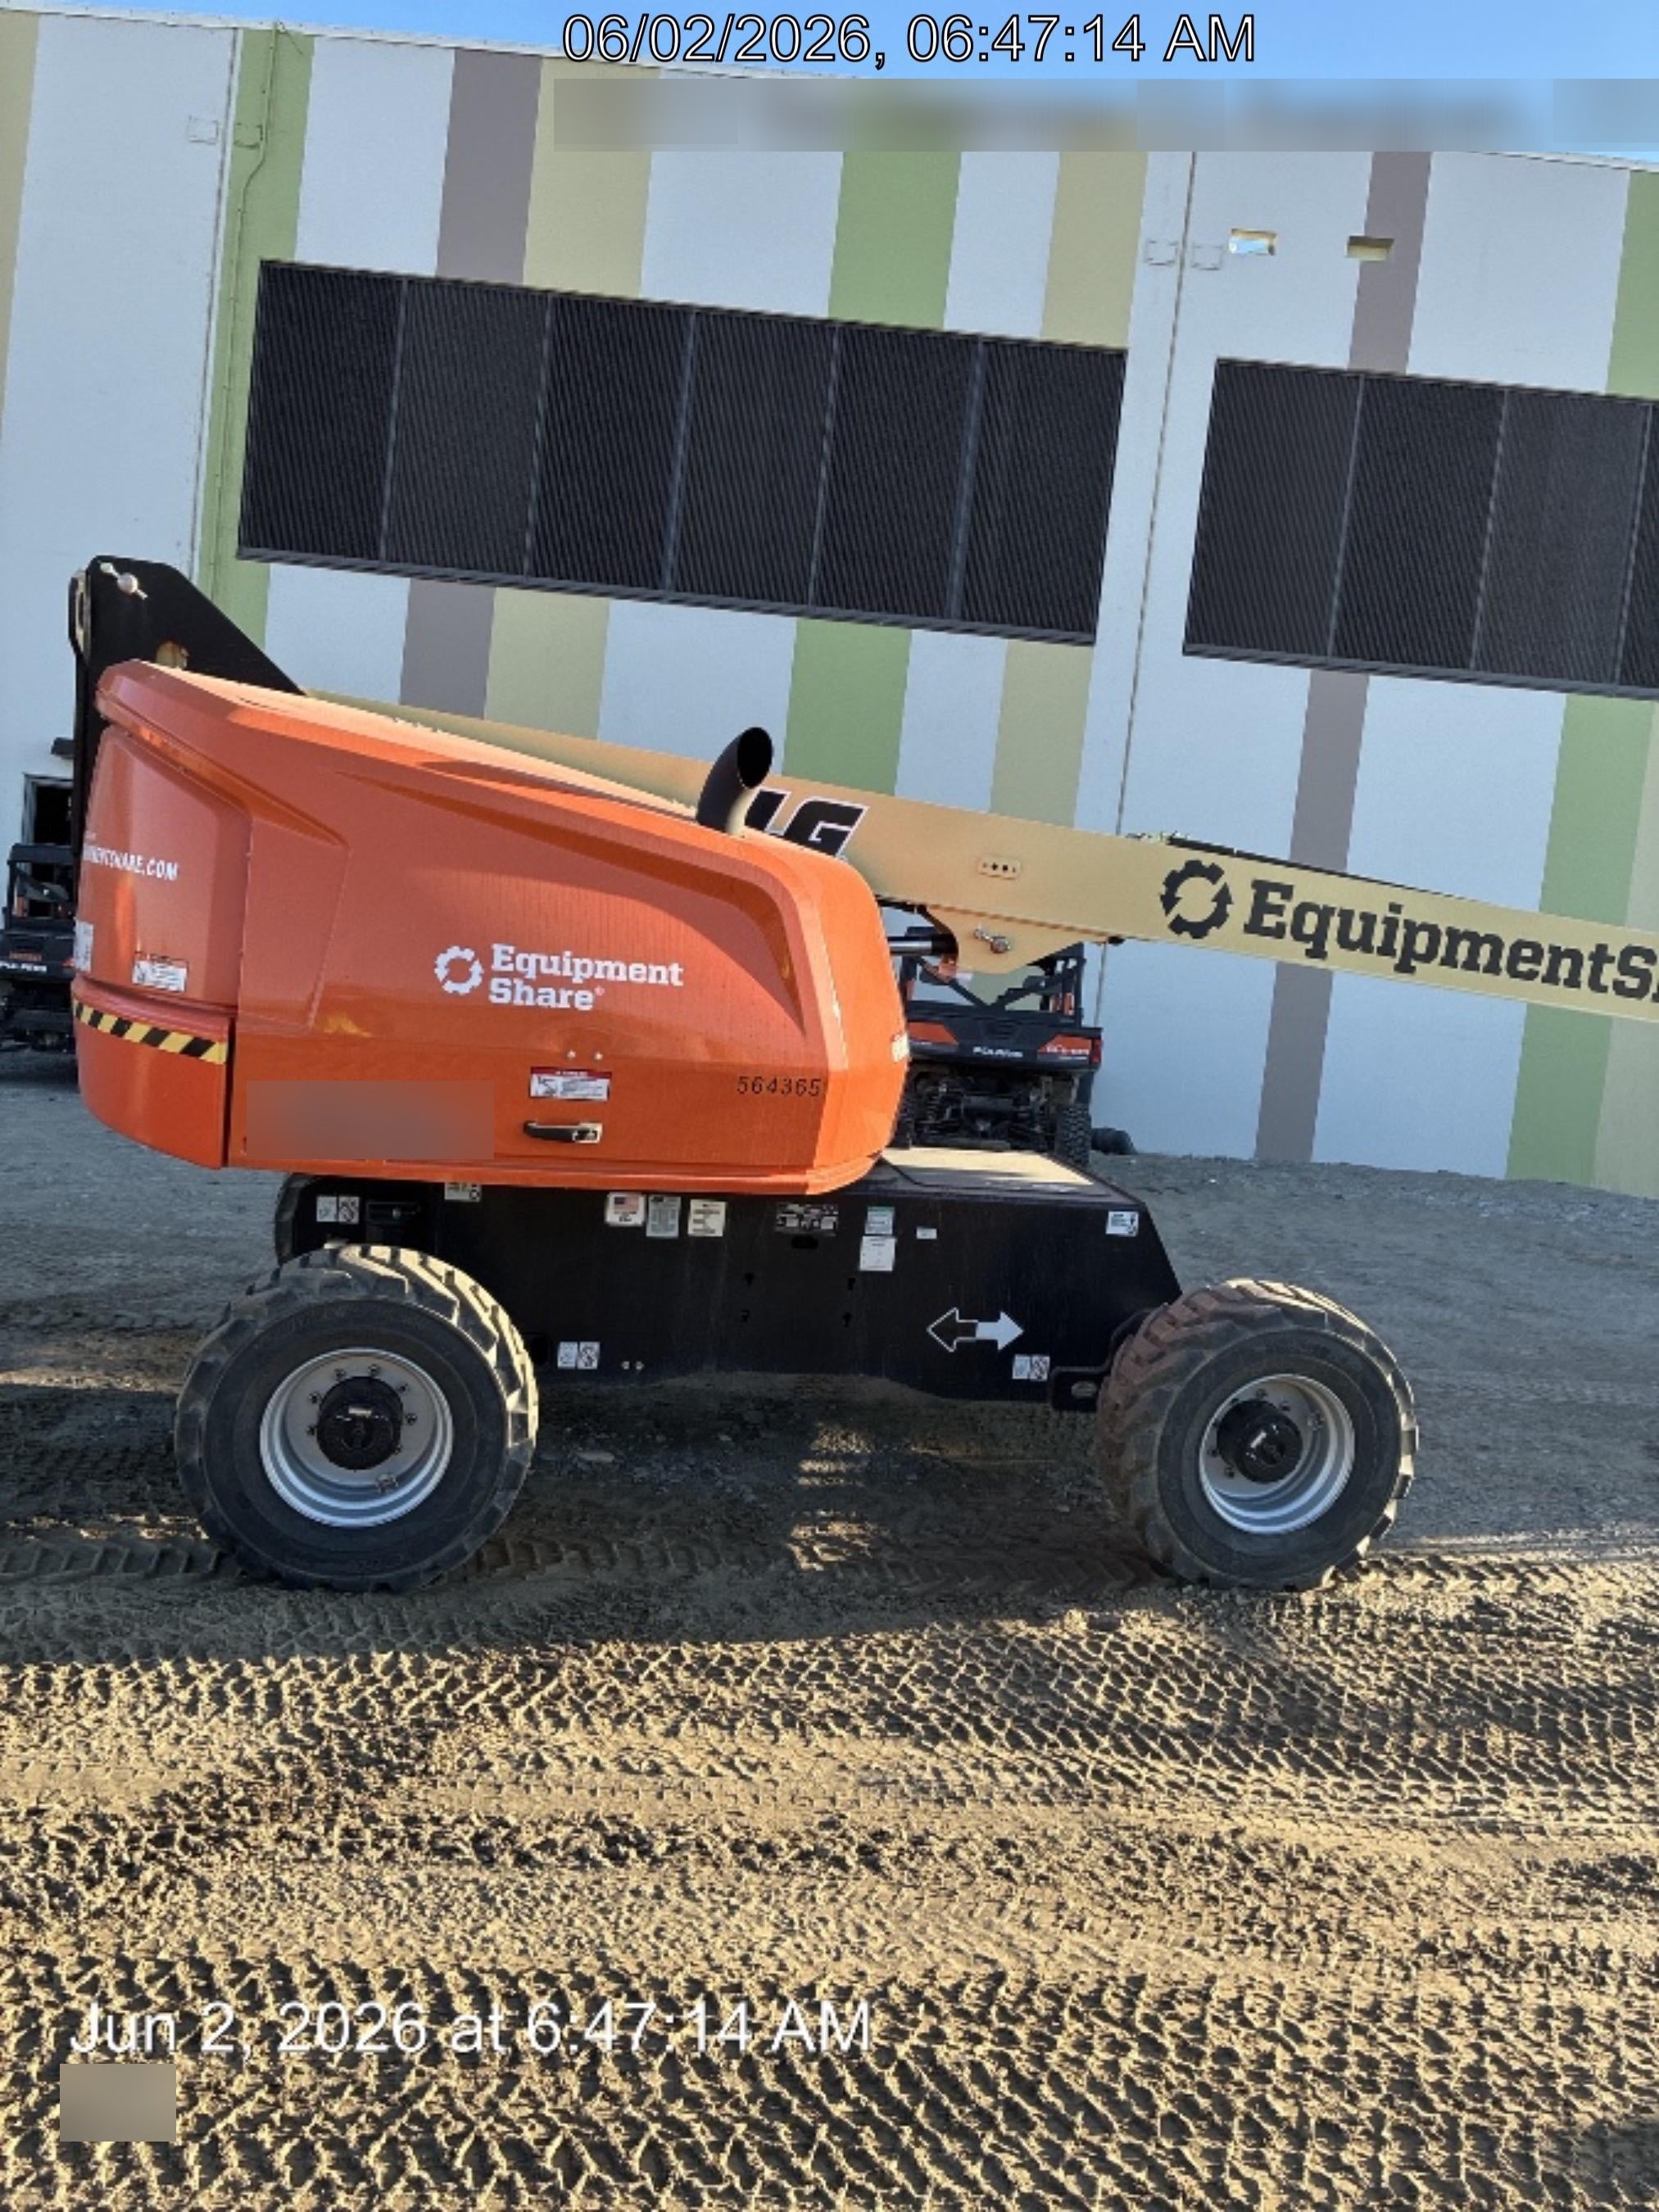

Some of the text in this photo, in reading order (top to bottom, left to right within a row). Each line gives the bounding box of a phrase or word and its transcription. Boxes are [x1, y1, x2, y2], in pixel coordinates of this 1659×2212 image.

[1243, 878, 1659, 1003] EquipmentS
[492, 943, 684, 986] Equipment
[737, 1076, 822, 1096] 564365
